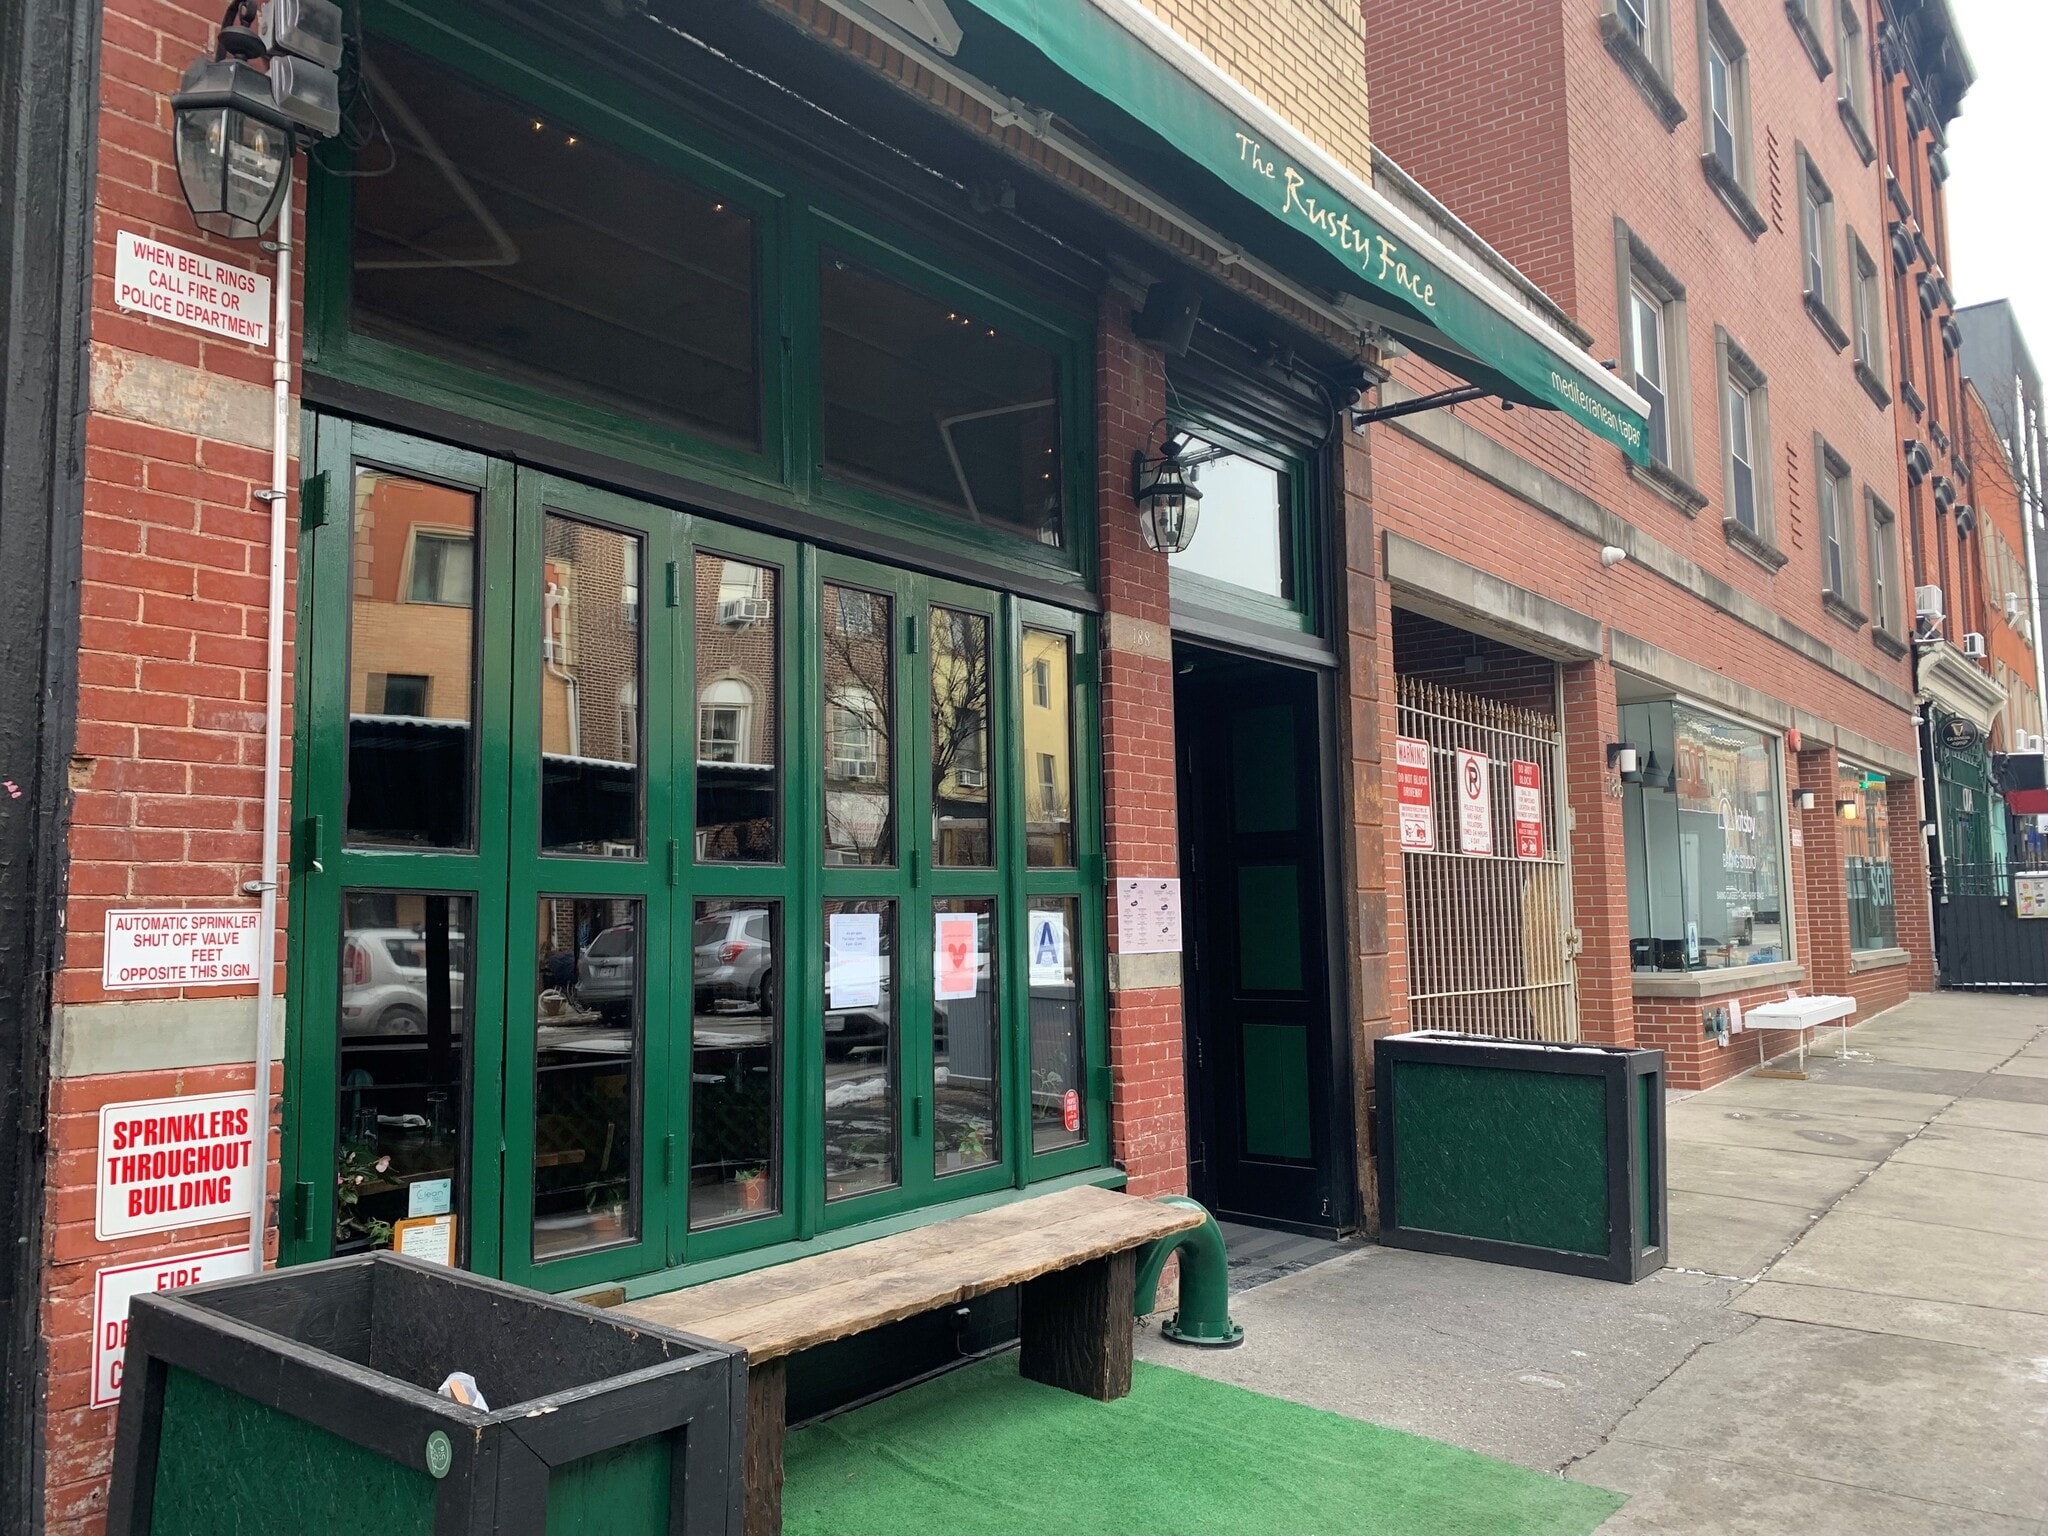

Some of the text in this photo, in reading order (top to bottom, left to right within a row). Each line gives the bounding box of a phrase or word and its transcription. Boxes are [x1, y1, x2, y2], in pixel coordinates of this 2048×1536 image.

[1235, 132, 1436, 307] The Rusty Face
[133, 240, 255, 293] WHEN BELL RINGS
[149, 269, 240, 311] CALL FIRE OR
[121, 284, 263, 340] POLICE DEPARTMENT
[1551, 371, 1641, 448] mediterranean tapas
[1133, 628, 1150, 647] 188
[1397, 743, 1426, 766] WARNING
[1404, 773, 1413, 784] NOT
[1413, 774, 1428, 786] BLOCK
[1734, 807, 1755, 839] kitsby
[115, 916, 256, 931] AUTOMATIC SPRINKLER
[133, 932, 239, 948] SHUT OFF VALVE
[191, 948, 223, 962] FEET
[1035, 922, 1058, 964] A
[119, 963, 250, 981] OPPOSITE THIS SIGN
[113, 1107, 249, 1151] SPRINKLERS
[107, 1140, 252, 1185] THROUGHOUT
[128, 1175, 231, 1218] BUILDING
[157, 1266, 202, 1291] FIRE
